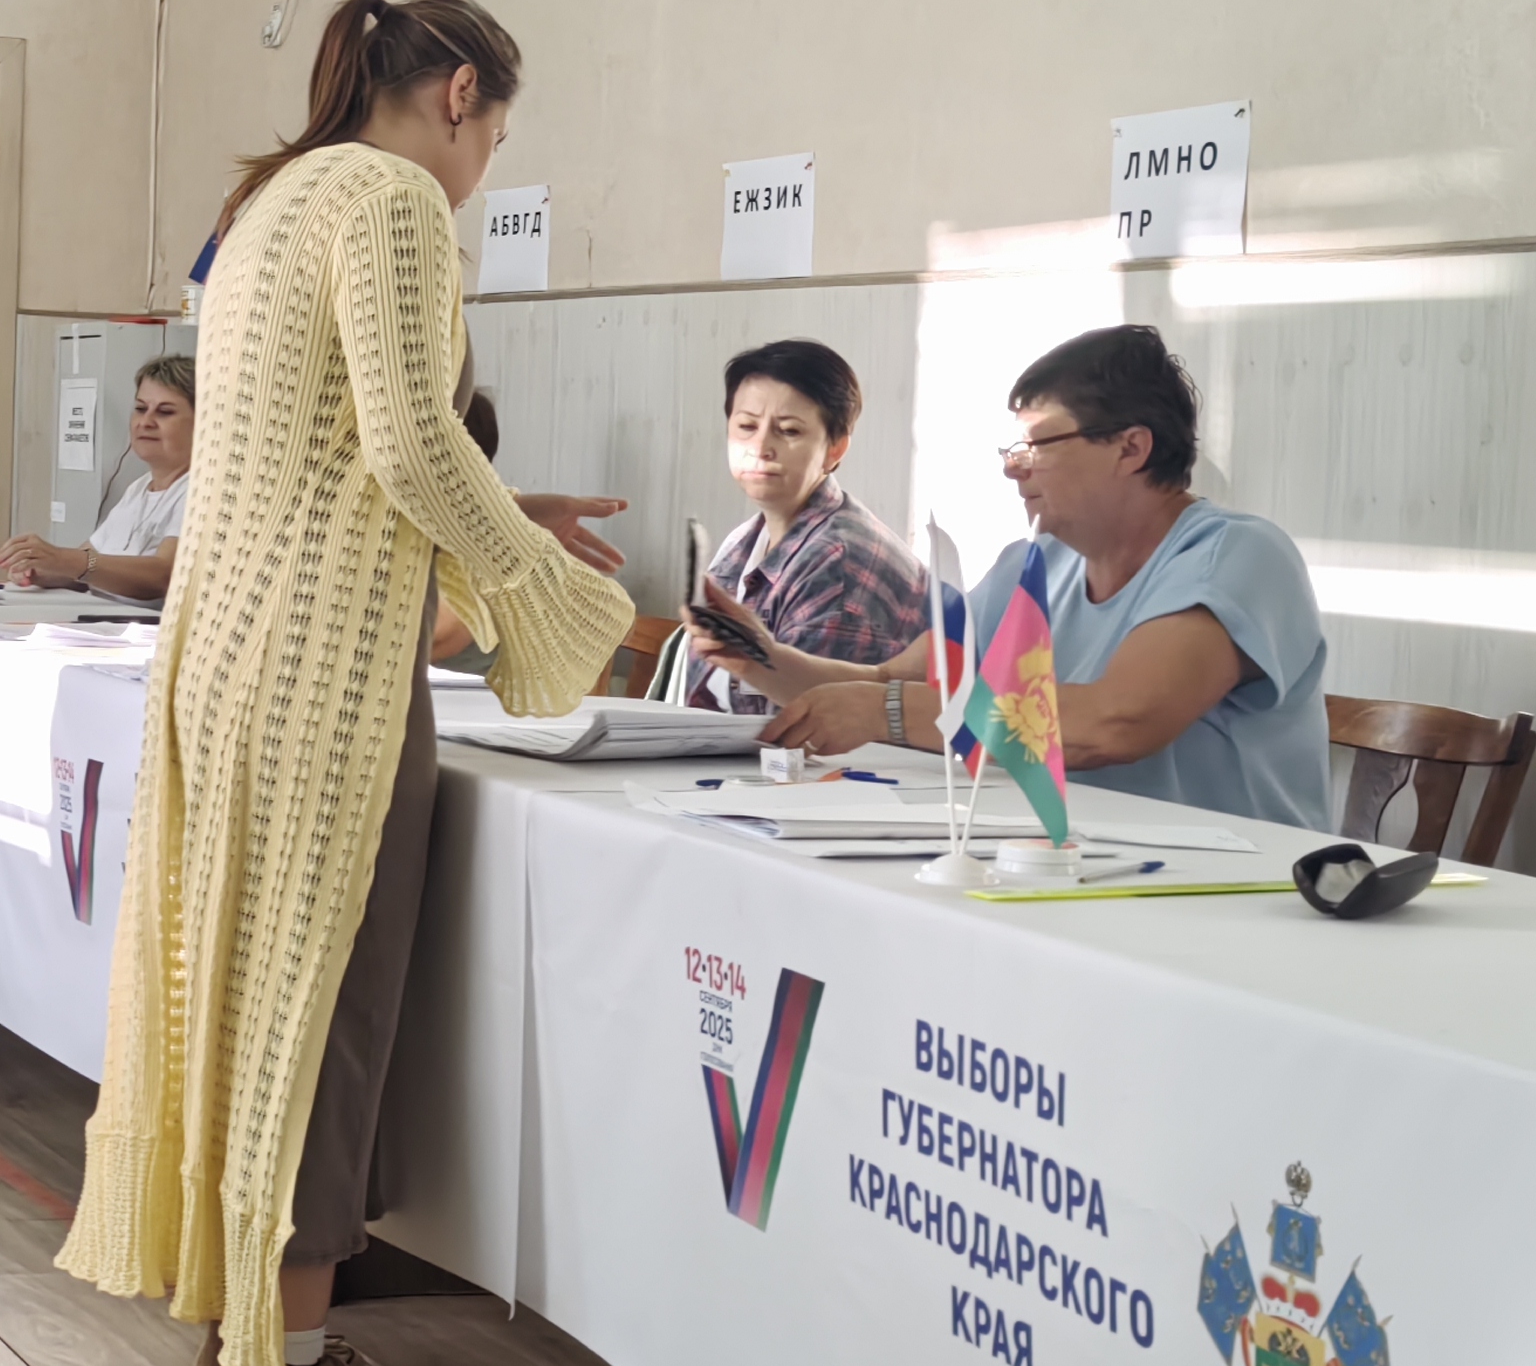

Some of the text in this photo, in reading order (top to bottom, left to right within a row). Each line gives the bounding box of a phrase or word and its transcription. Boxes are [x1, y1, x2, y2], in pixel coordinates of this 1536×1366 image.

[489, 210, 542, 239] АБВГД
[699, 1007, 734, 1045] 2025
[915, 1018, 1066, 1128] ВЫБОРЫ
[881, 1087, 1109, 1239] ГУБЕРНАТОРА
[848, 1153, 1155, 1349] КРАСНОДАРСКОГО
